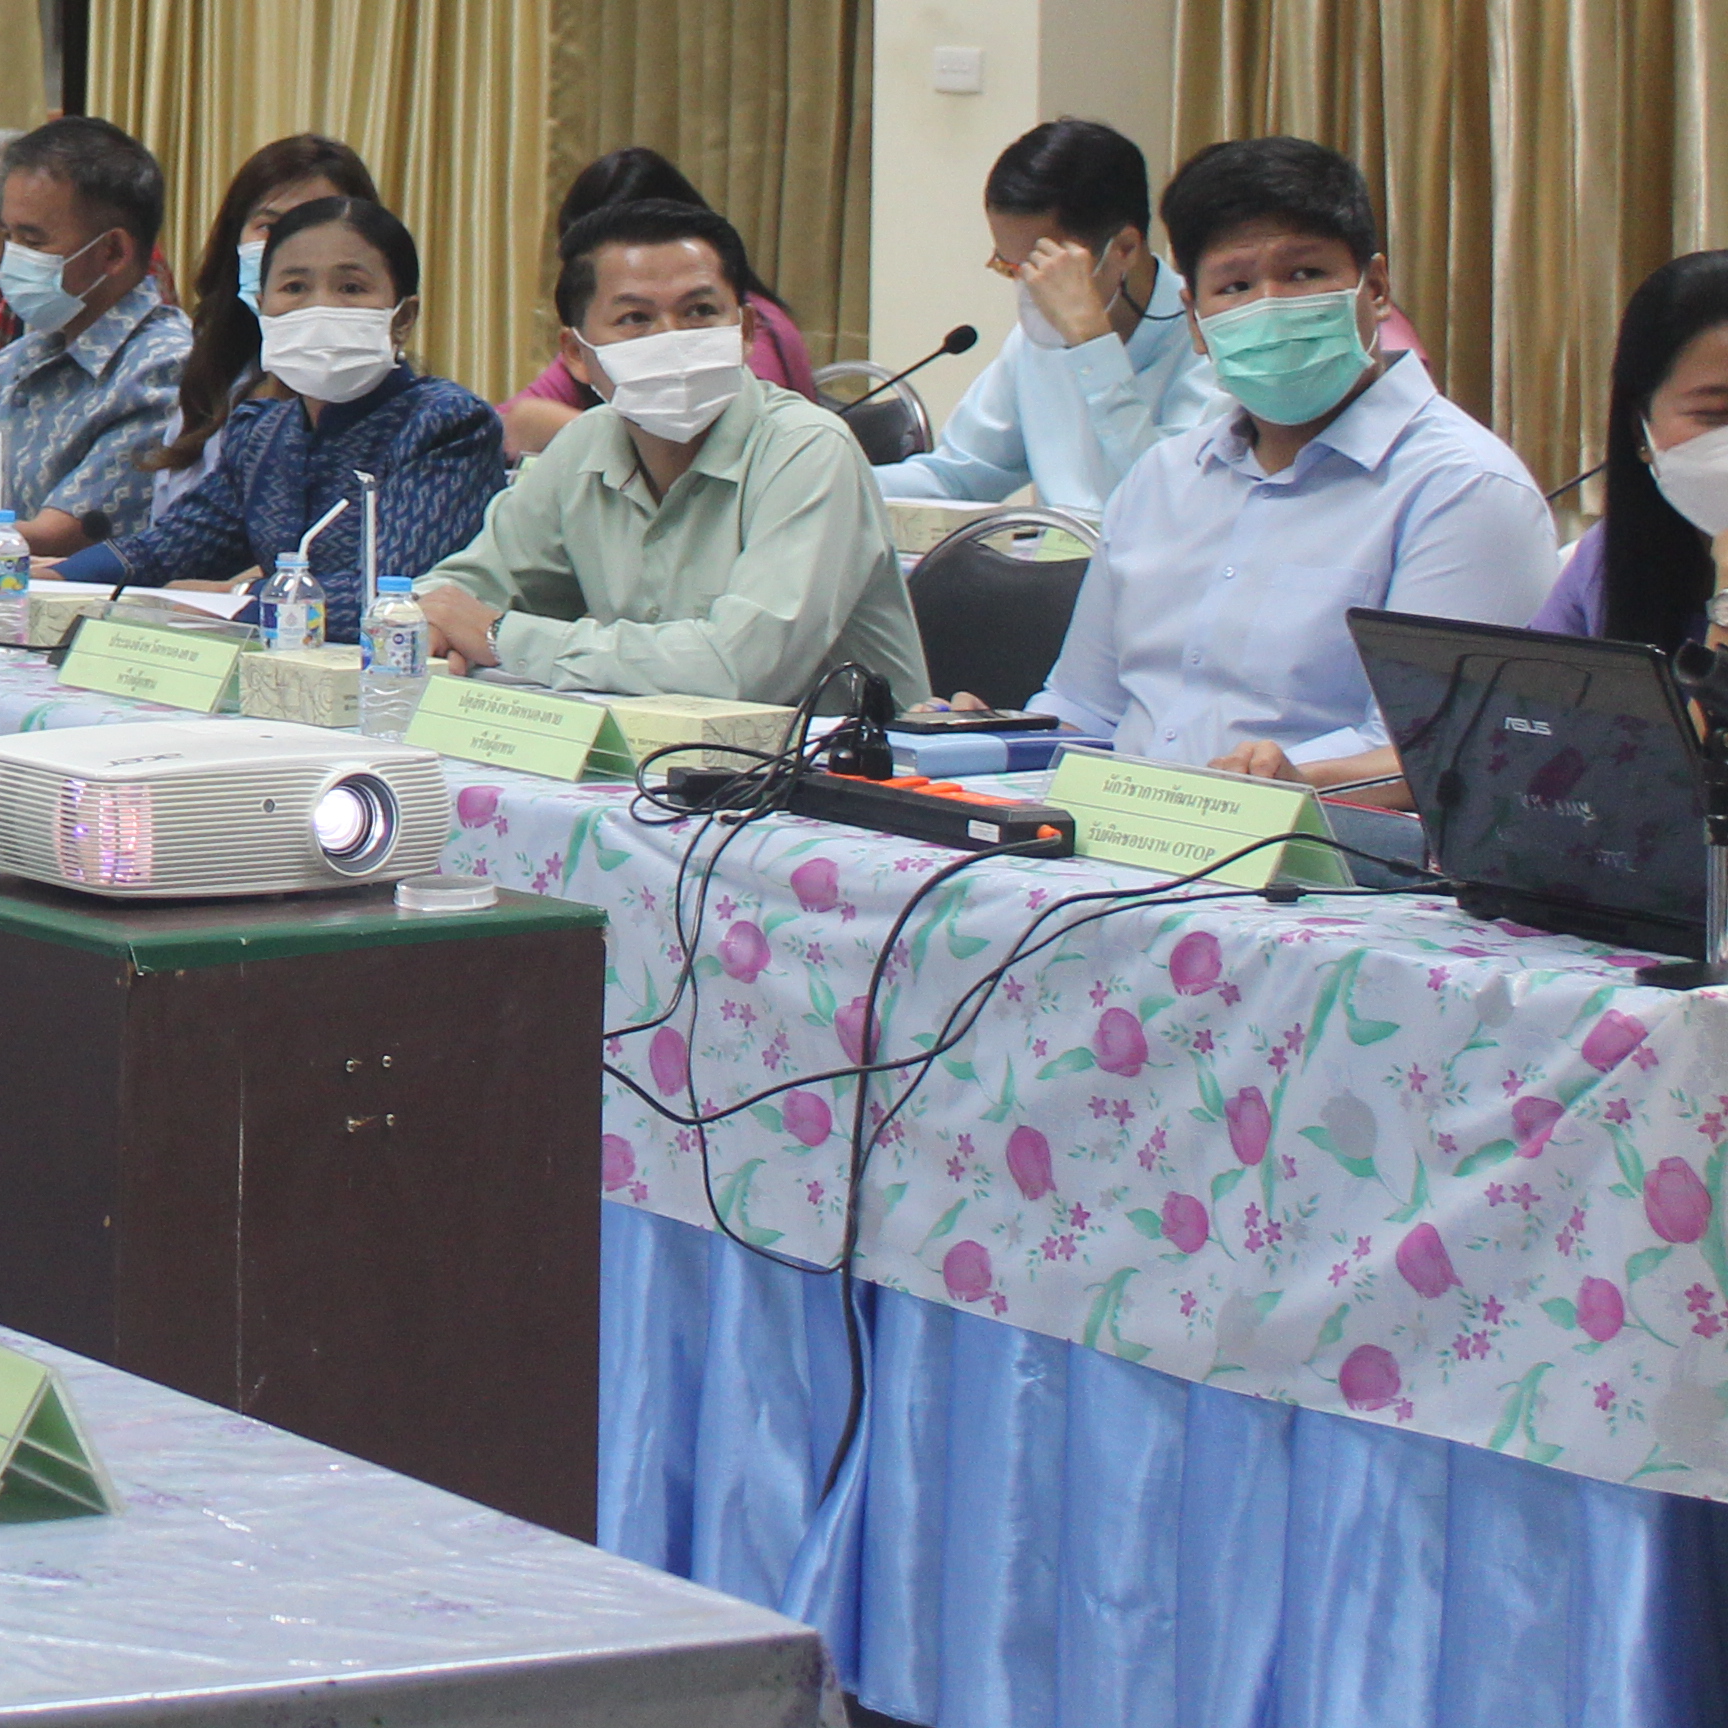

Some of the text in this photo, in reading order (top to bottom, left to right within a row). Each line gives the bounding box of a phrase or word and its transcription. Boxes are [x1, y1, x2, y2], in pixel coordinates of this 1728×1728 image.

[1504, 716, 1552, 736] ASUS
[1102, 773, 1242, 816] นักวิชาการพัฒนาชุมชน
[1172, 841, 1216, 862] OTOP
